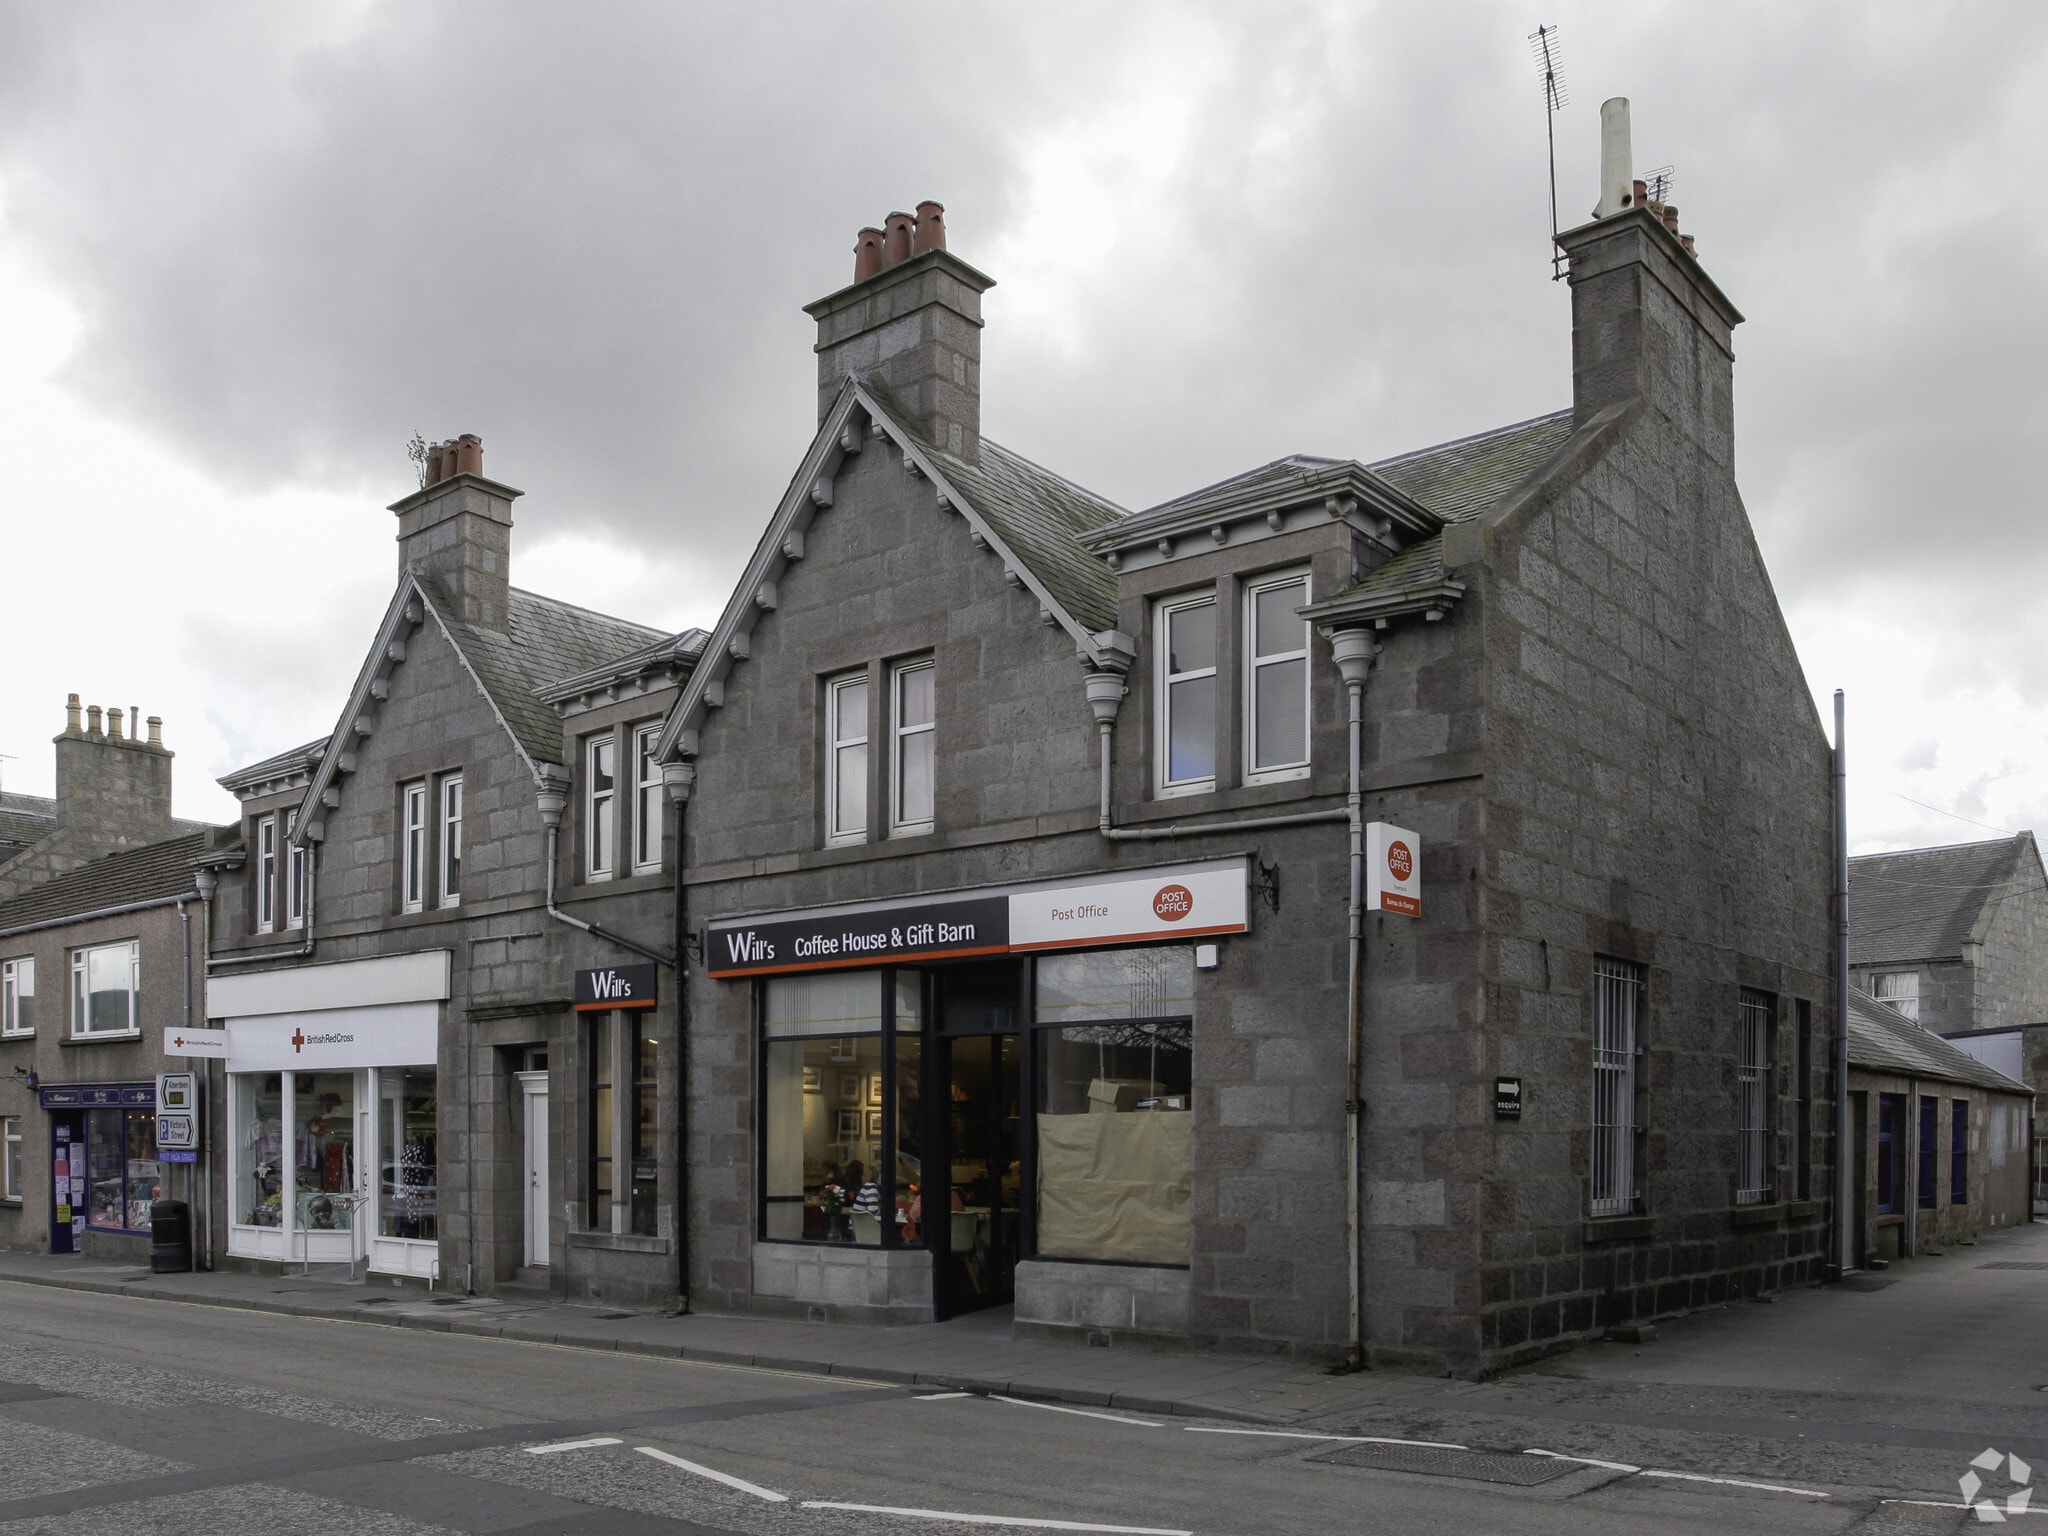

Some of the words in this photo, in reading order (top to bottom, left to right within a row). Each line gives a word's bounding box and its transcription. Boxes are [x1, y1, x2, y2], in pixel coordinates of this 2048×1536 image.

[1393, 848, 1408, 861] POST
[1389, 858, 1410, 873] OFFICE
[1161, 891, 1185, 903] POST
[1051, 908, 1074, 921] Post
[1077, 904, 1109, 919] Office
[1156, 901, 1188, 914] OFFICE
[726, 931, 775, 963] Will's
[794, 933, 839, 957] Coffee
[842, 931, 887, 952] House
[890, 927, 904, 947] &
[906, 923, 935, 946] Gift
[938, 922, 975, 943] Barn
[591, 970, 632, 999] Will's
[168, 1080, 188, 1089] Aberdeen
[169, 1120, 186, 1129] Victoria
[170, 1130, 185, 1139] Street
